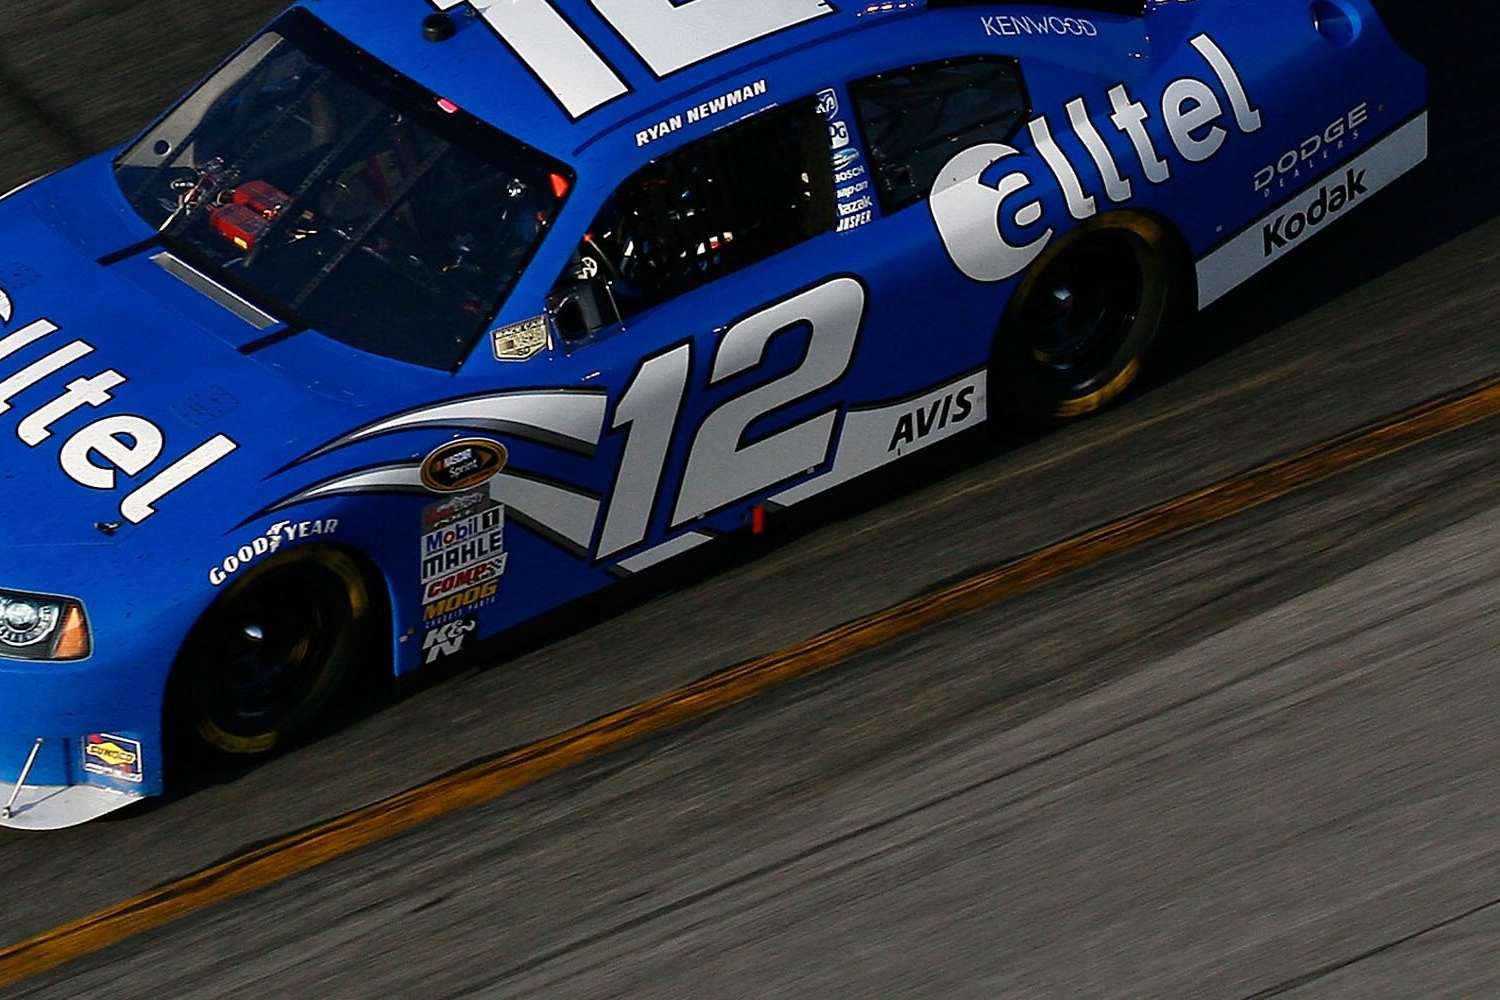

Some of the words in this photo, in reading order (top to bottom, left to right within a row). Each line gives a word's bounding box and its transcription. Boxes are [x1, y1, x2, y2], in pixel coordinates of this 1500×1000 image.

[980, 16, 1098, 36] KENWOOD
[636, 115, 683, 147] RYAN
[686, 79, 767, 124] NEWMAN
[1254, 102, 1368, 191] DODGE
[929, 33, 1262, 282] alltel
[1263, 130, 1359, 198] DEALERS
[1263, 168, 1368, 257] Kodak
[595, 277, 865, 561] 12
[888, 386, 976, 453] AVIS
[423, 530, 502, 579] MAHLE
[426, 516, 478, 552] Mobil
[423, 579, 499, 621] MOOG
[427, 562, 488, 598] COMP
